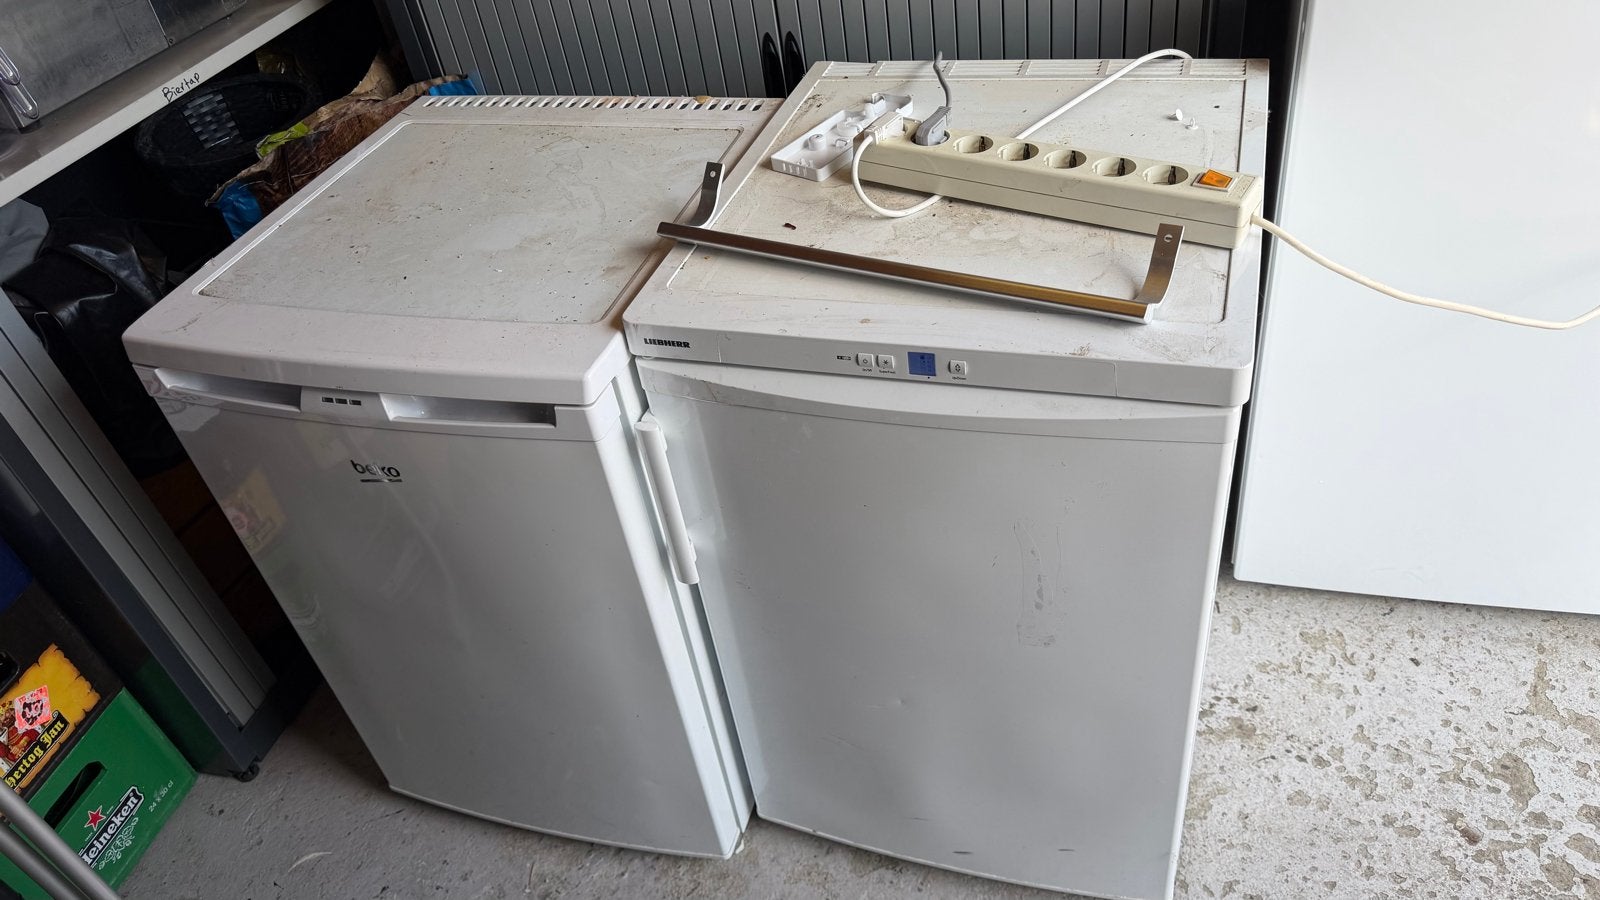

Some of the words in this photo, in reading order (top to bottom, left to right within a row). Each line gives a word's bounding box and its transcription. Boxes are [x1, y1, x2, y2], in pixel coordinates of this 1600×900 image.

[162, 72, 200, 103] Biertap
[643, 337, 691, 348] LIEBHERR
[4, 744, 44, 788] Hertog
[40, 720, 65, 749] Jan
